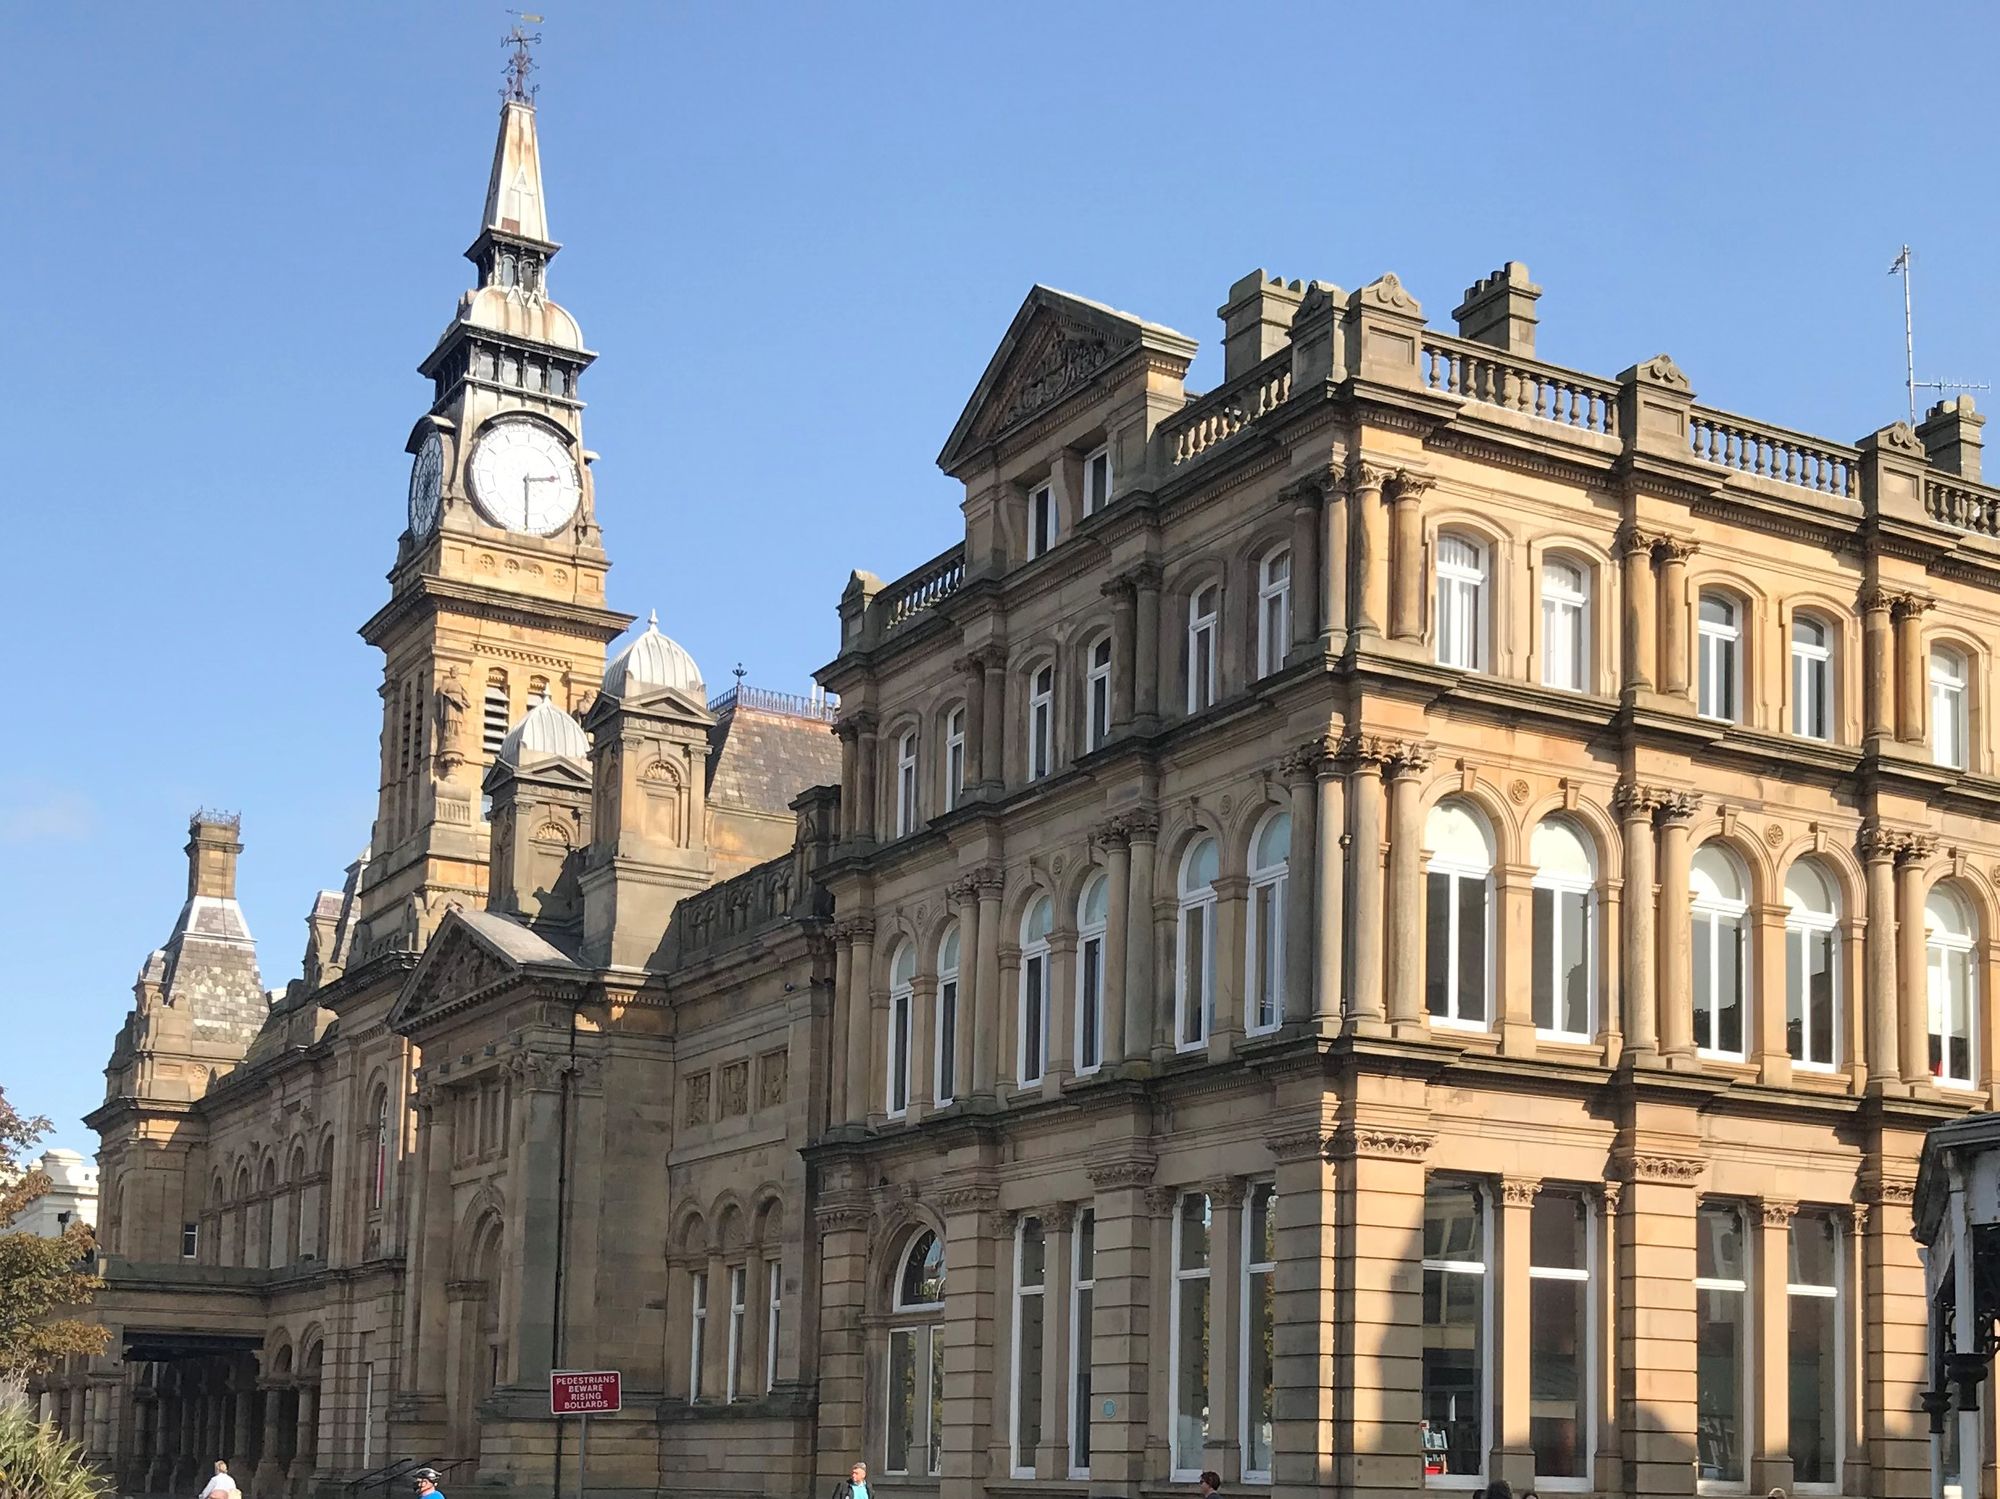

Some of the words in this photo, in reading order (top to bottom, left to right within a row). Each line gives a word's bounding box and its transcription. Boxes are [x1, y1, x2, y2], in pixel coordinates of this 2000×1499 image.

[556, 1376, 615, 1384] PEDESTRIANS
[568, 1384, 603, 1392] BEWARE
[571, 1392, 601, 1400] RISING
[564, 1400, 608, 1408] BOLLARDS
